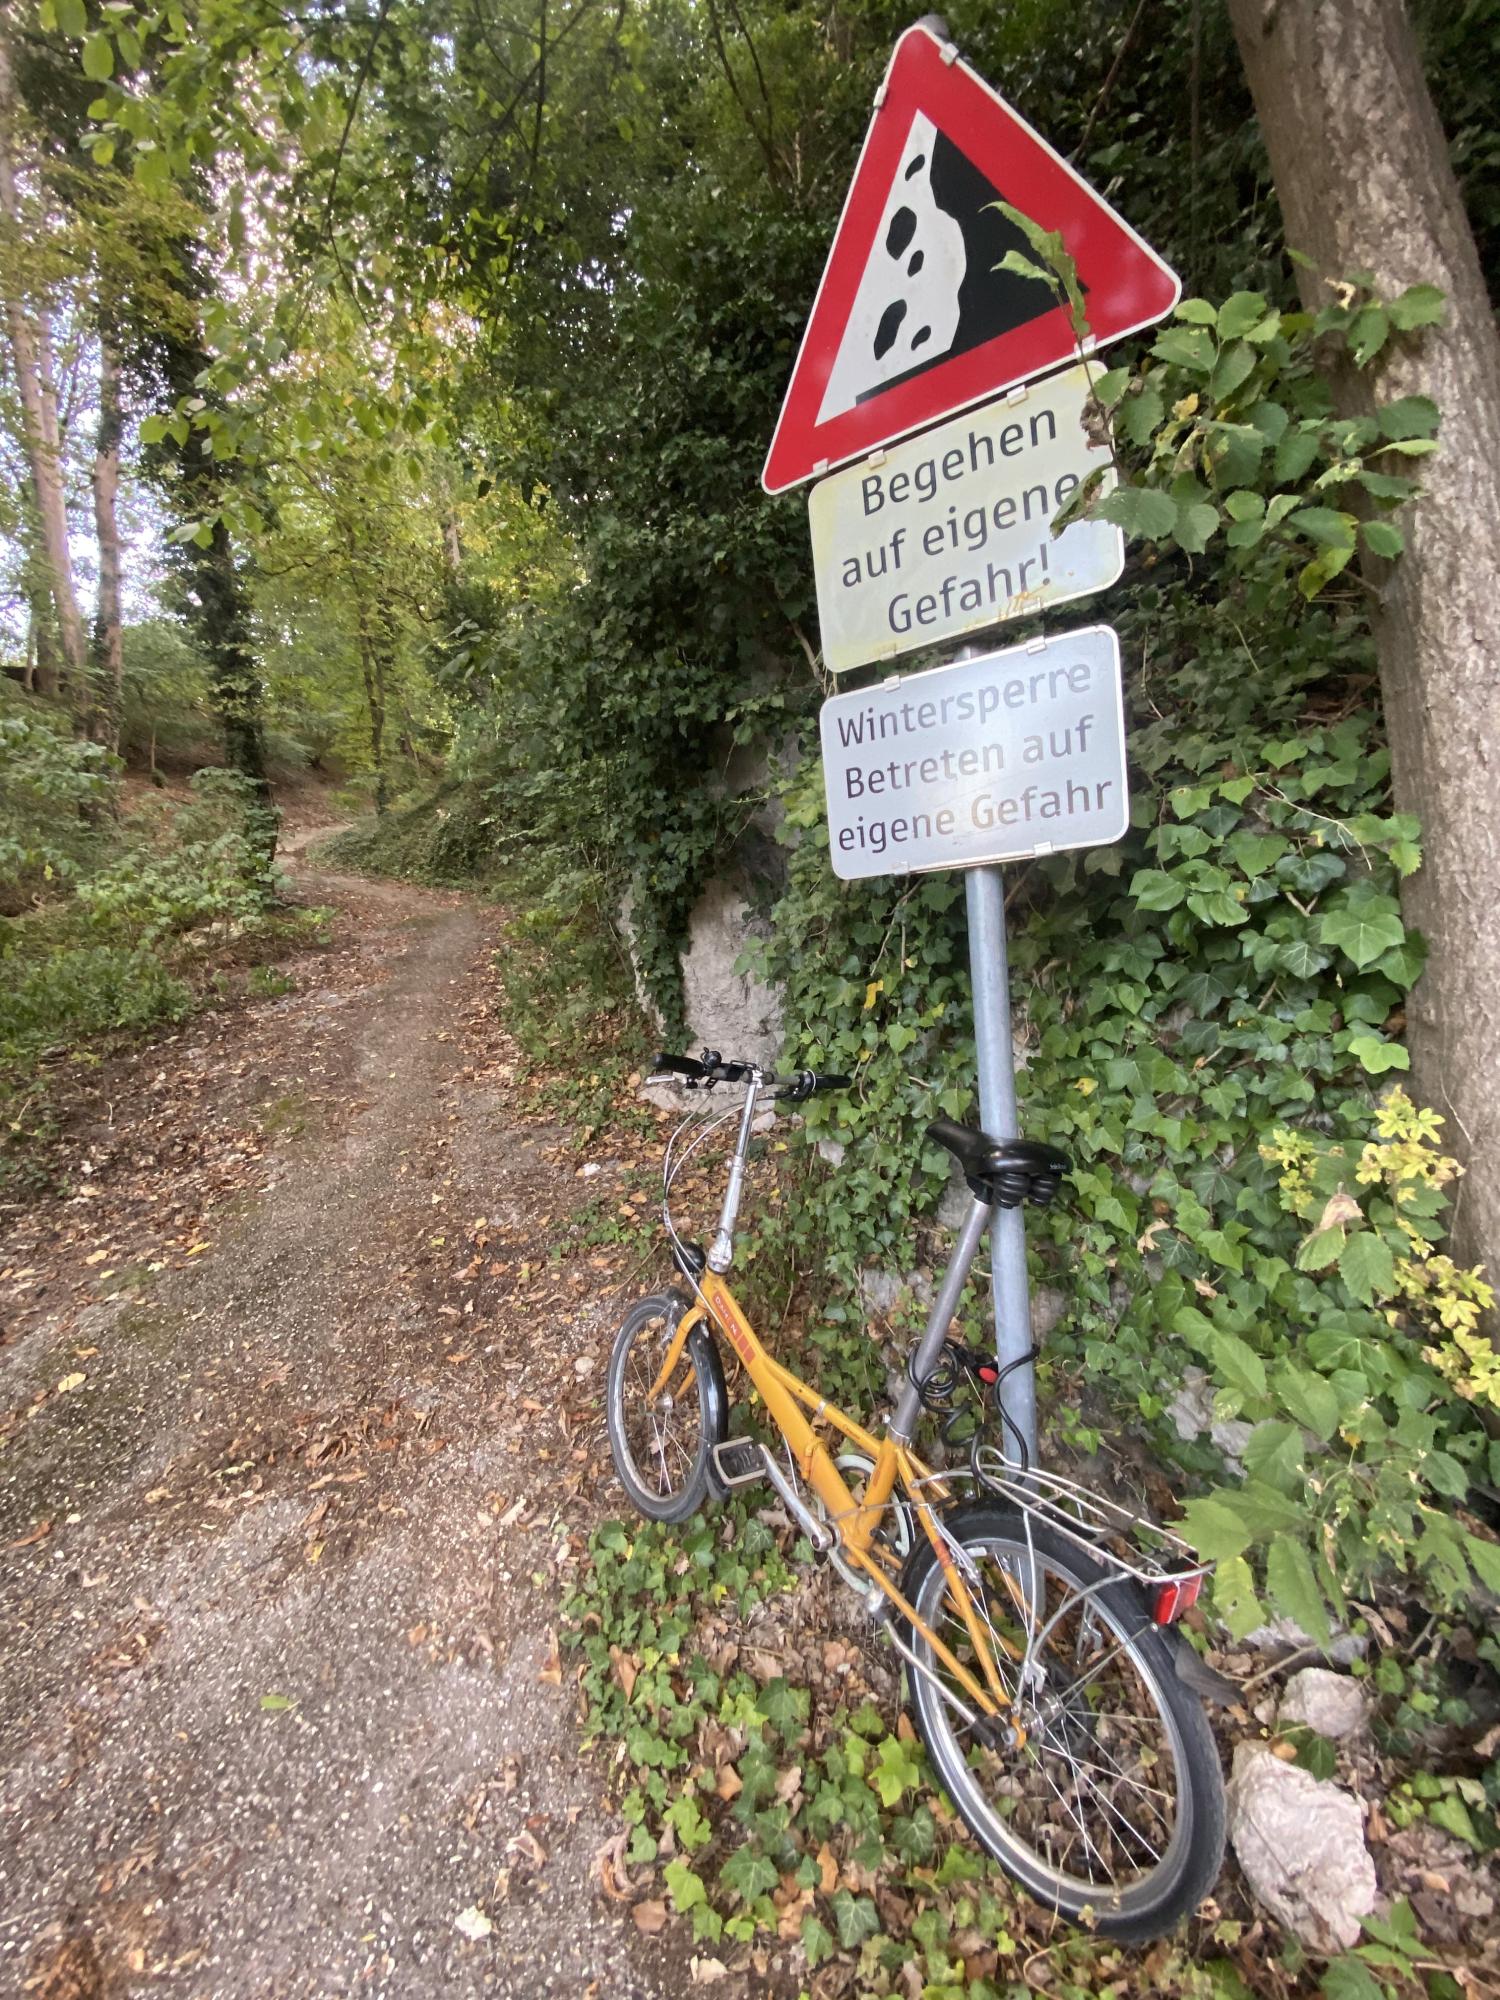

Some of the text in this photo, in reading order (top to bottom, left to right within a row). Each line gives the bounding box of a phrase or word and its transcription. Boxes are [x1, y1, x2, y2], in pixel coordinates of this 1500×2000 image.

[861, 409, 1057, 516] Begehen
[842, 472, 1080, 588] auf eigene
[888, 543, 1051, 633] Gefahr!
[838, 662, 1091, 747] Wintersperre
[845, 714, 1094, 799] Betreten auf
[838, 779, 1113, 853] eigene Gefahr
